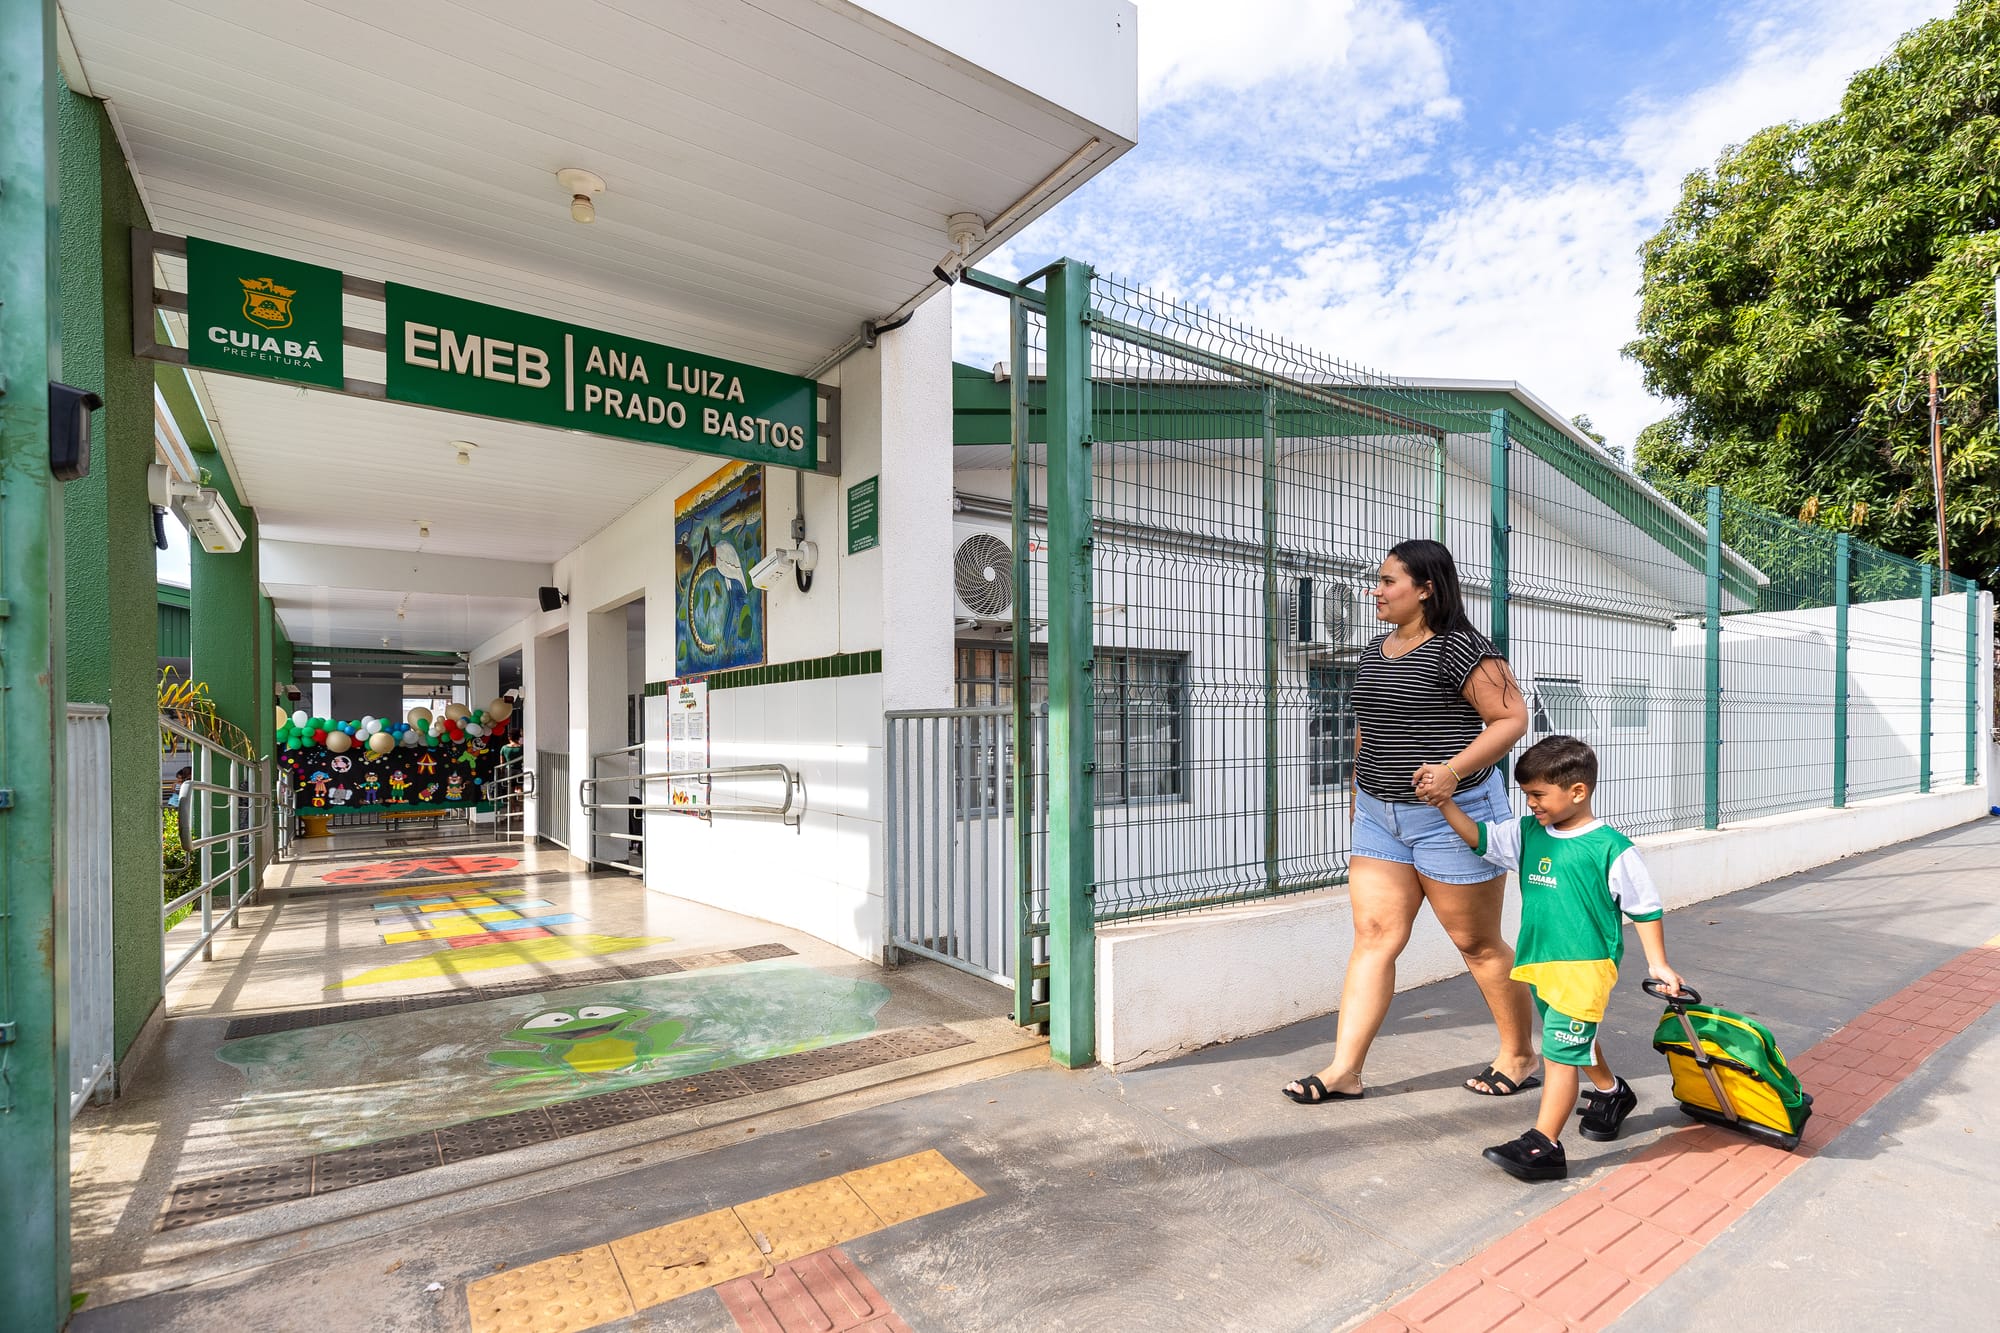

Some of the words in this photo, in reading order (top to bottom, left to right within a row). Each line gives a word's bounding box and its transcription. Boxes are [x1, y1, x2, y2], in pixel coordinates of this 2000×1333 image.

[208, 327, 323, 362] CUIABÁ
[223, 346, 311, 368] PREFEITURA
[404, 320, 551, 388] EMEB
[584, 345, 649, 385] ANA
[666, 362, 745, 403] LUIZA
[584, 384, 687, 428] PRADO
[703, 408, 804, 451] BASTOS
